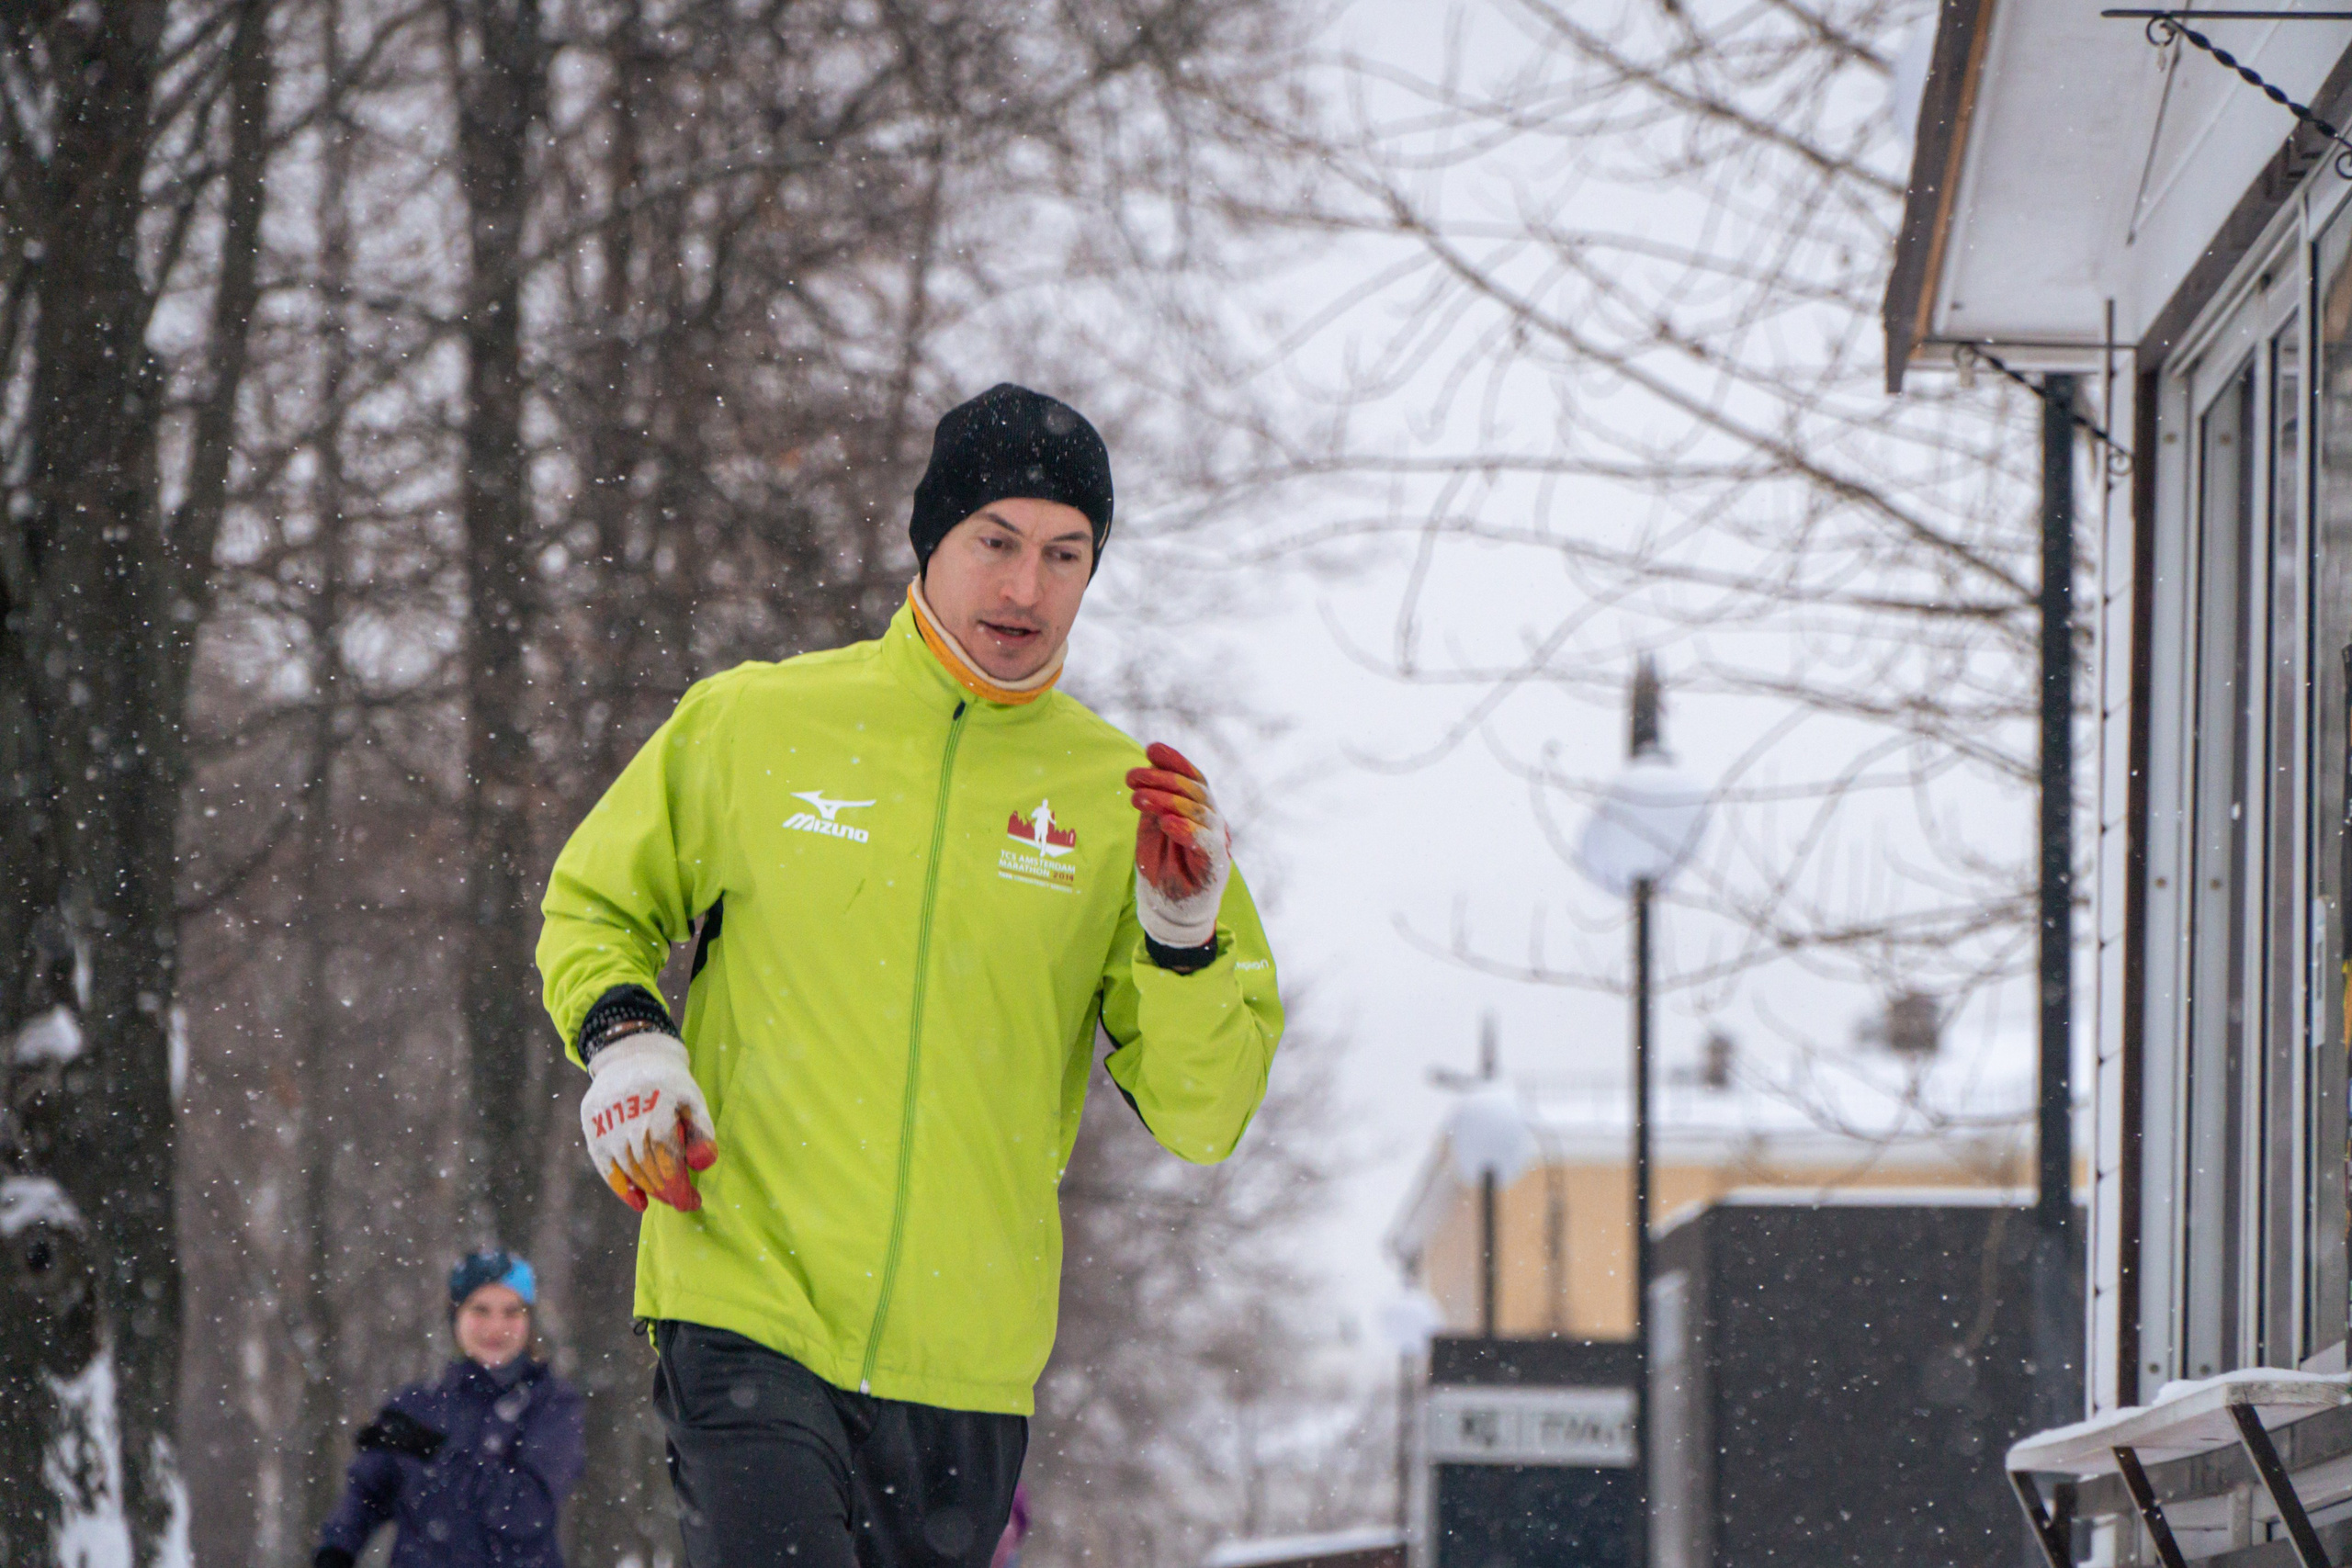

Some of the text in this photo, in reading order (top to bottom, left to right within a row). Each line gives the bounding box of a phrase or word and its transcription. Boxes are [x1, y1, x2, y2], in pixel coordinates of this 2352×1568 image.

[998, 859, 1050, 877] MARATHON
[1001, 849, 1076, 874] TCS AMSTERDAM
[592, 1089, 661, 1138] FELIX
